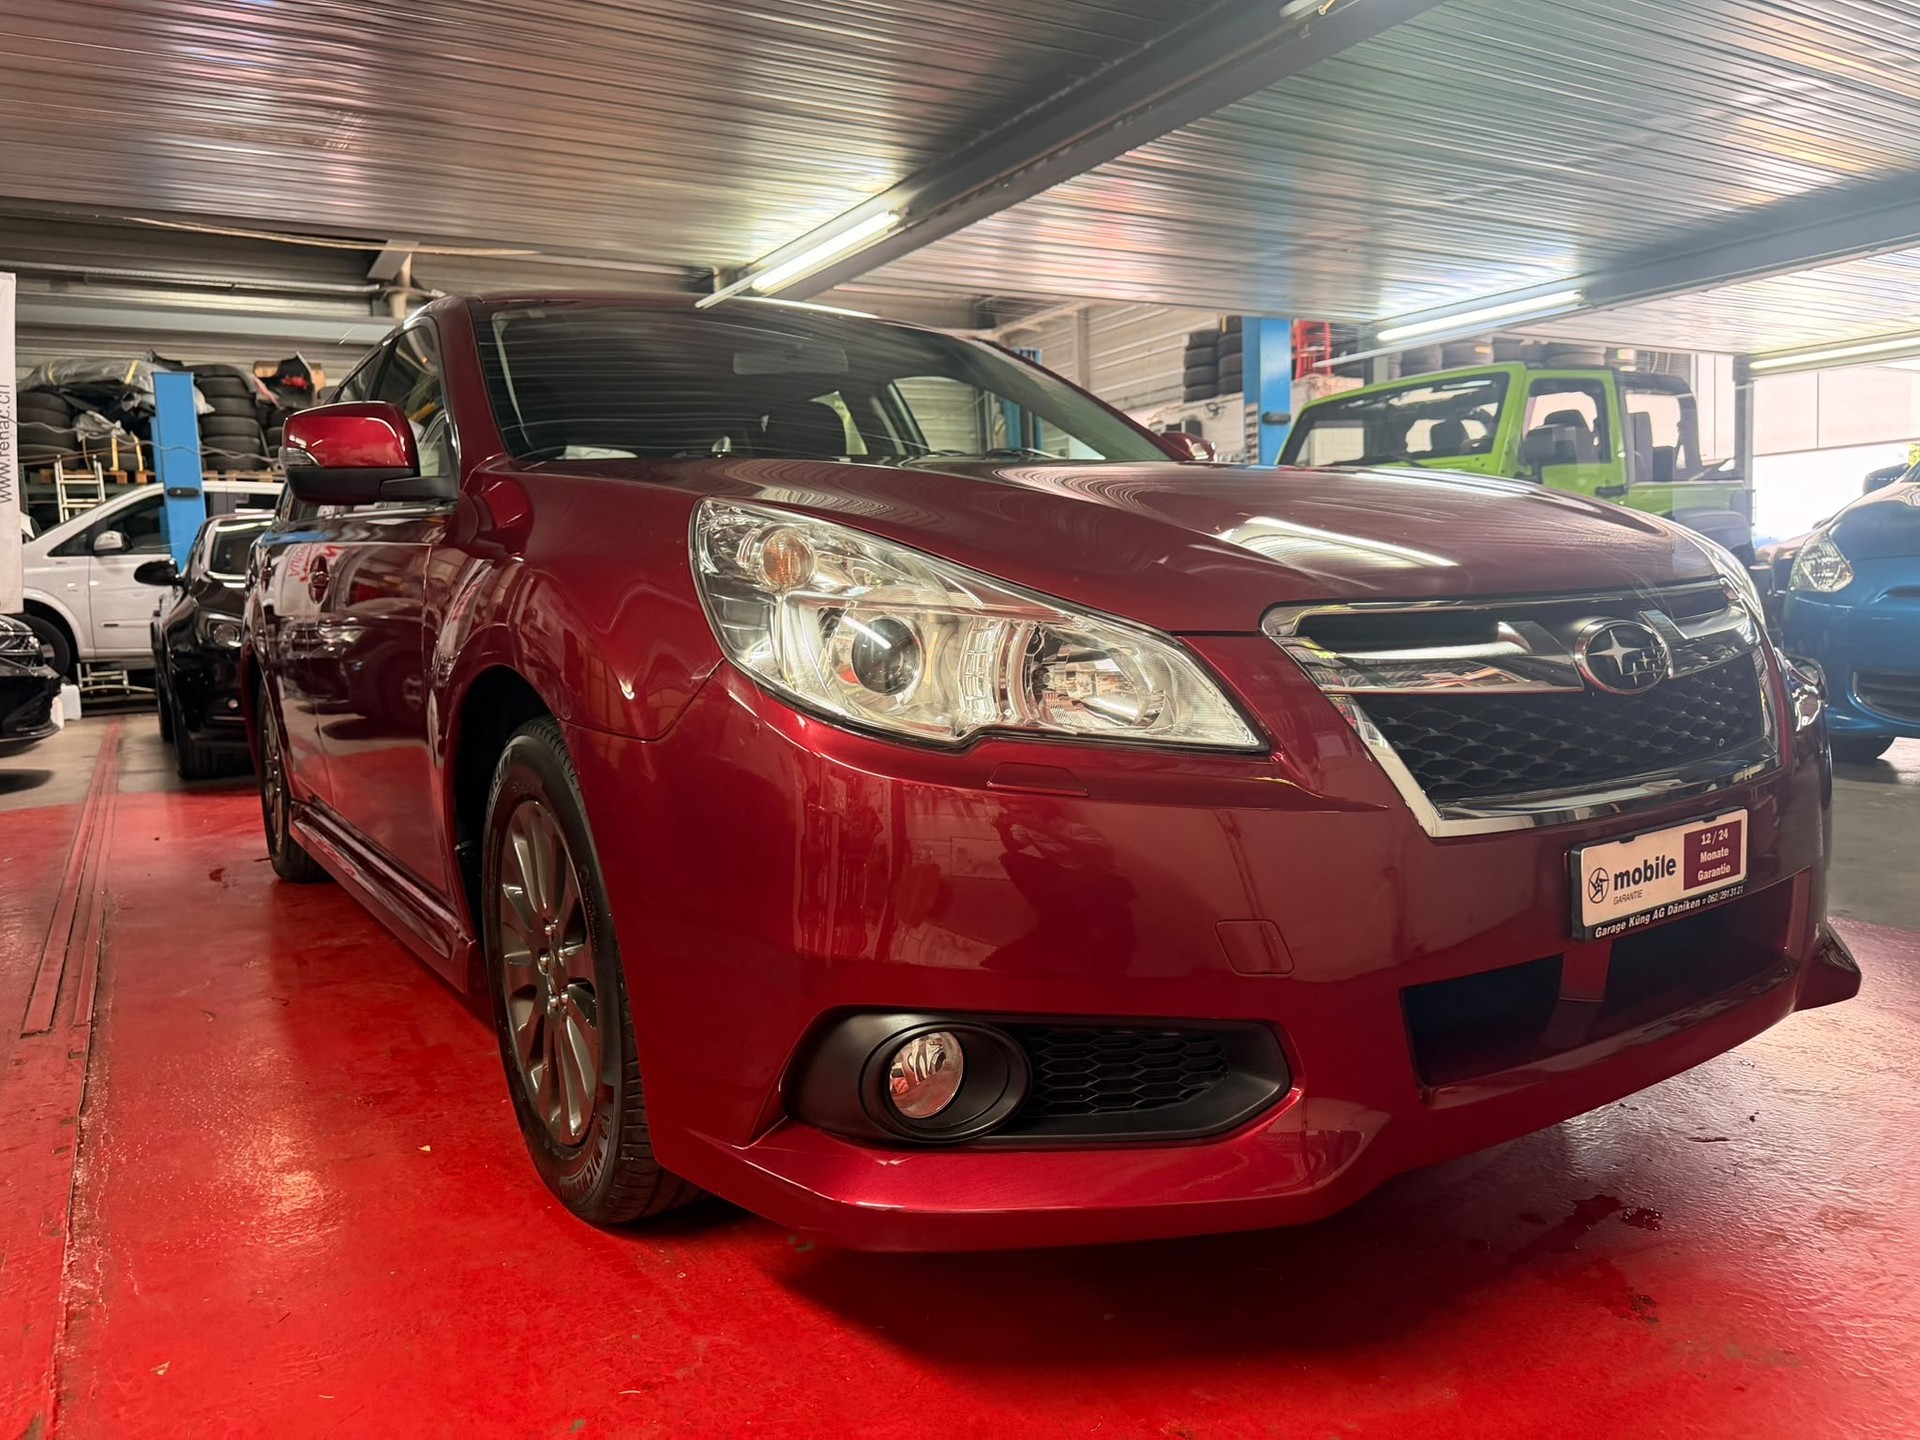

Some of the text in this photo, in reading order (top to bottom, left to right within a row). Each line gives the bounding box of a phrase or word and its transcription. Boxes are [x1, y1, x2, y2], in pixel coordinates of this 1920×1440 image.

[1701, 832, 1712, 846] 12
[1718, 828, 1729, 841] 24
[1700, 847, 1729, 863] Monate
[1614, 854, 1677, 891] mobile
[1697, 862, 1731, 881] Garantie
[1613, 889, 1643, 905] GARANTIE
[1595, 921, 1626, 938] Garage
[1628, 914, 1651, 927] Küng
[1652, 907, 1665, 921] AG
[1667, 899, 1701, 915] Däniken
